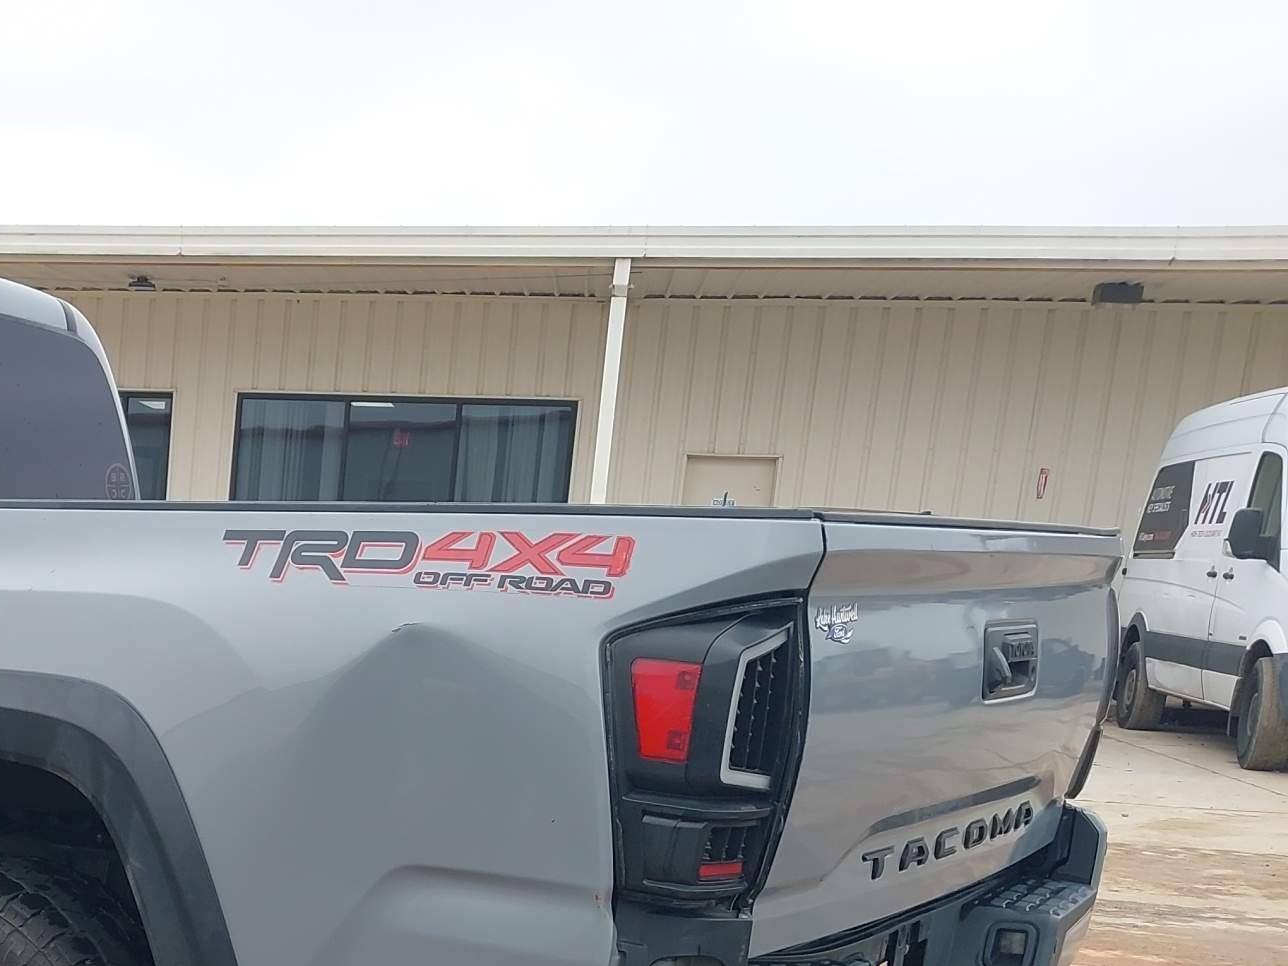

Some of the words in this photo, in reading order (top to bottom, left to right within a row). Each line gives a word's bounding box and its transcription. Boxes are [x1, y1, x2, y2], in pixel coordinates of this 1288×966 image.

[223, 530, 423, 583] TRD
[422, 531, 635, 577] 4X4
[413, 571, 493, 589] OFF
[497, 575, 614, 598] ROAD
[862, 800, 1034, 880] TACOMA
